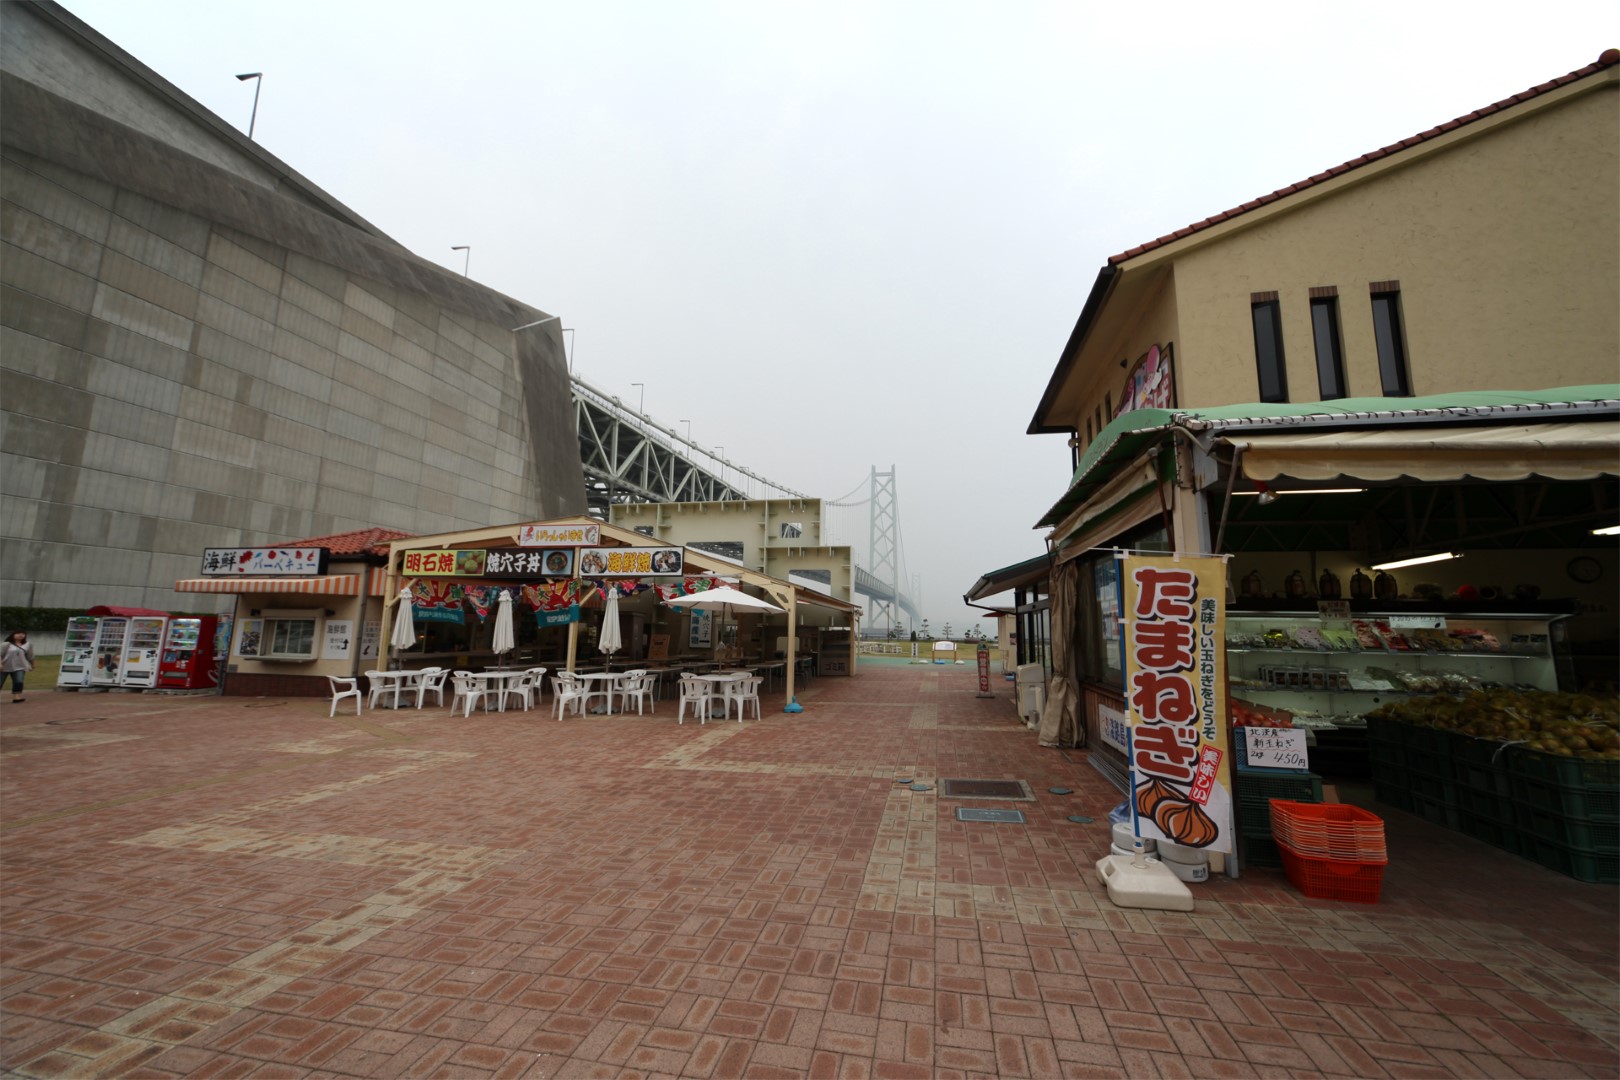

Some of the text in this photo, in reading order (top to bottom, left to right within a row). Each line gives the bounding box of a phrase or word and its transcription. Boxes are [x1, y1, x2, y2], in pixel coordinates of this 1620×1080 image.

[535, 529, 584, 542] いらっしゃいませ
[204, 551, 316, 572] 海鮮 バーベキュー
[405, 553, 454, 573] 明石焼
[486, 552, 541, 573] 焼穴子丼
[607, 551, 651, 573] 海鮮焼
[1132, 567, 1197, 784] たまねぎ
[1200, 598, 1217, 741] 美味しい玉ねぎをどうぞ
[1192, 748, 1219, 802] 美味しい
